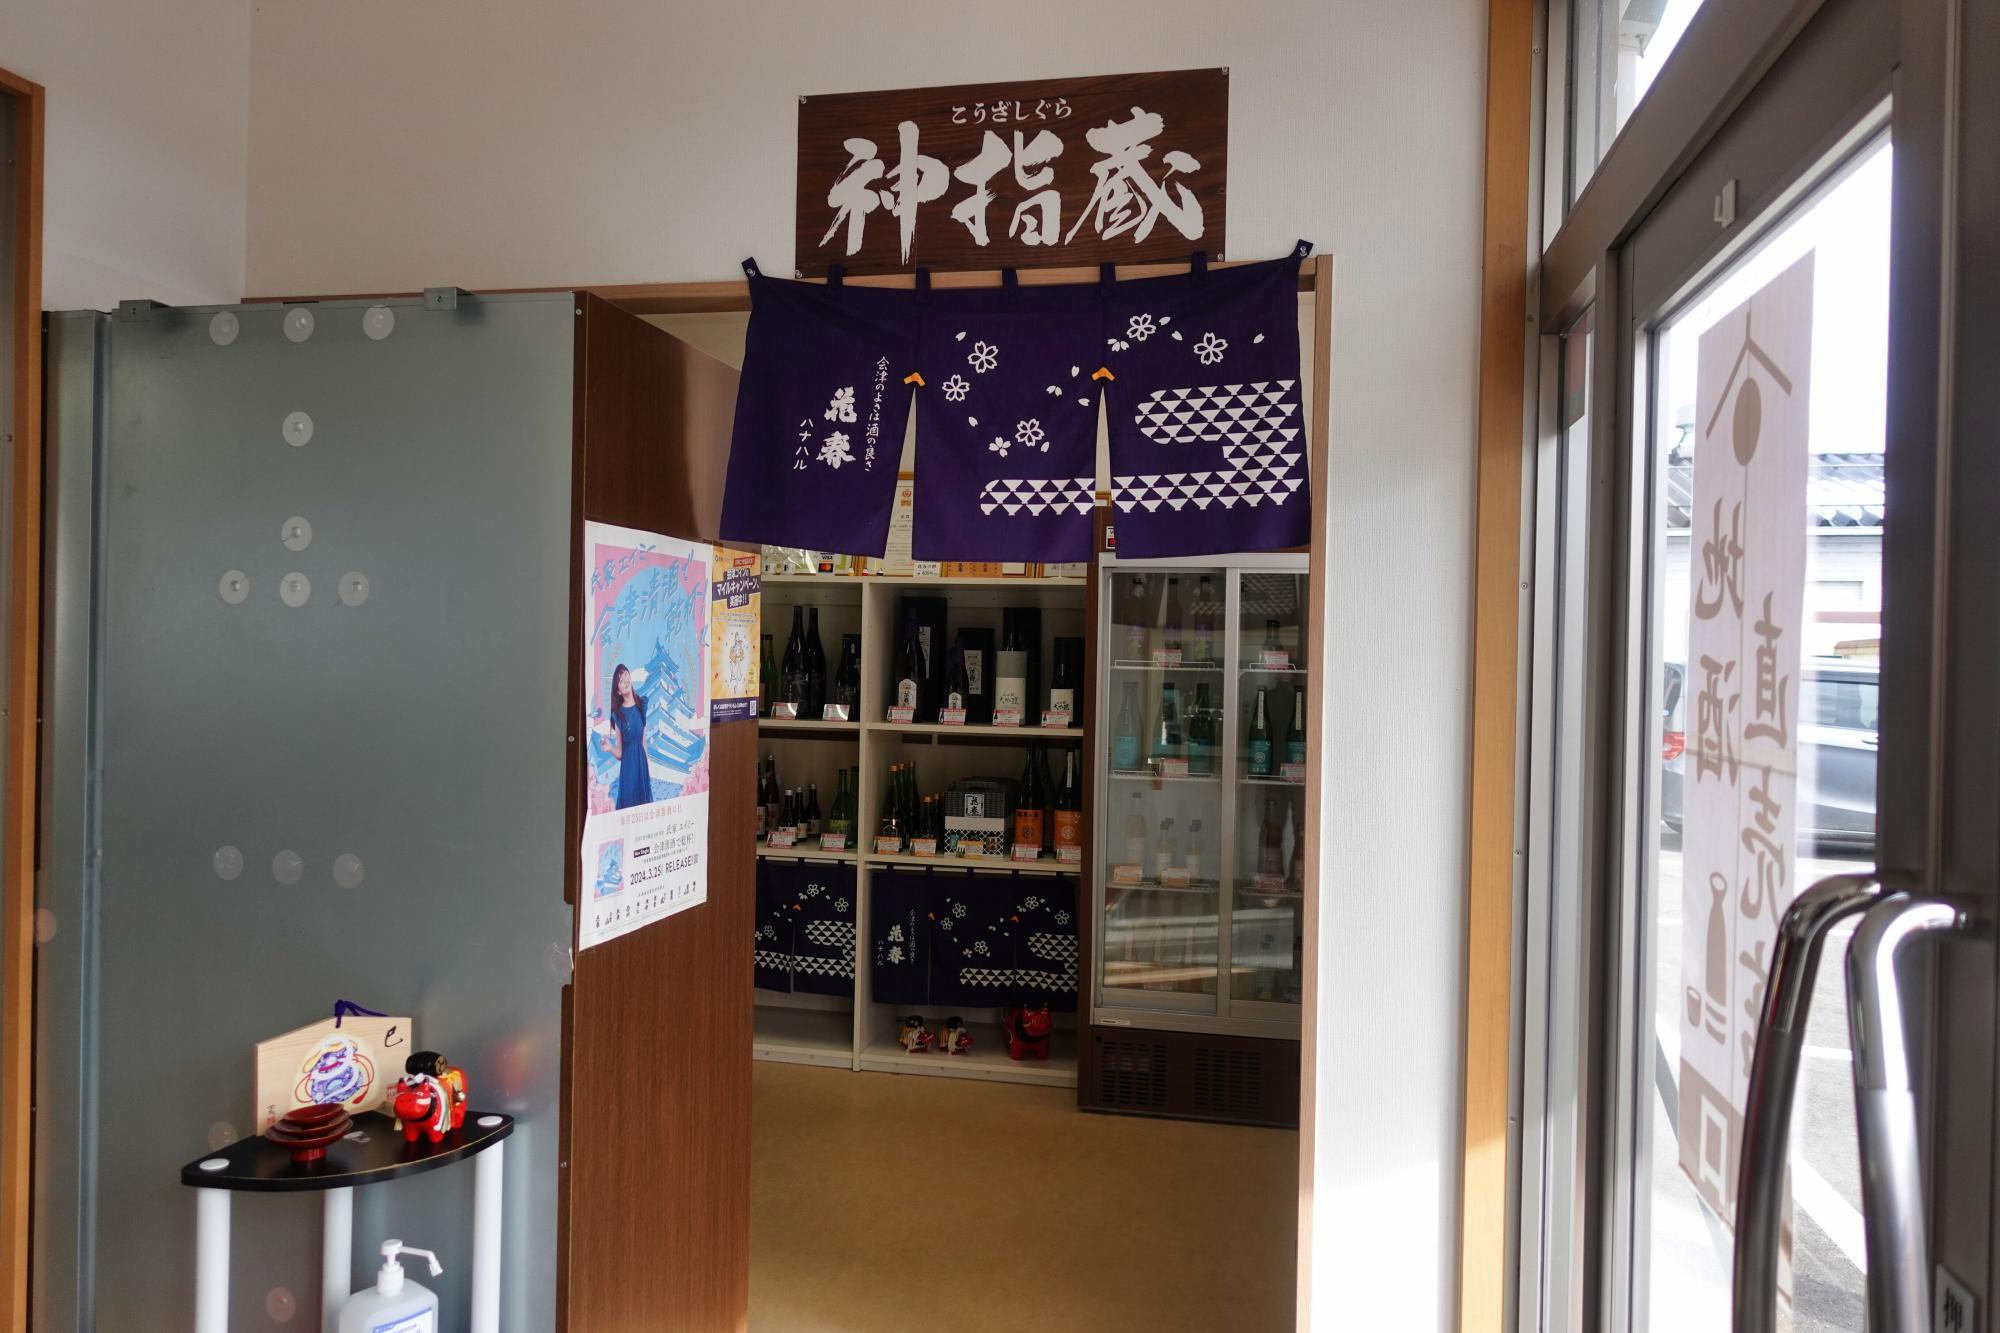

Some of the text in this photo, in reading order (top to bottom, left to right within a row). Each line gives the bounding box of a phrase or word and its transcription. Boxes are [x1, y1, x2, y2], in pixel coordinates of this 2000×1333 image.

[951, 98, 1073, 125] こうざしぐら
[819, 106, 1204, 266] 神指蔵
[793, 418, 814, 470] ハナハル
[816, 386, 858, 469] 花春
[864, 356, 890, 472] 会津のよさは酒の良さ
